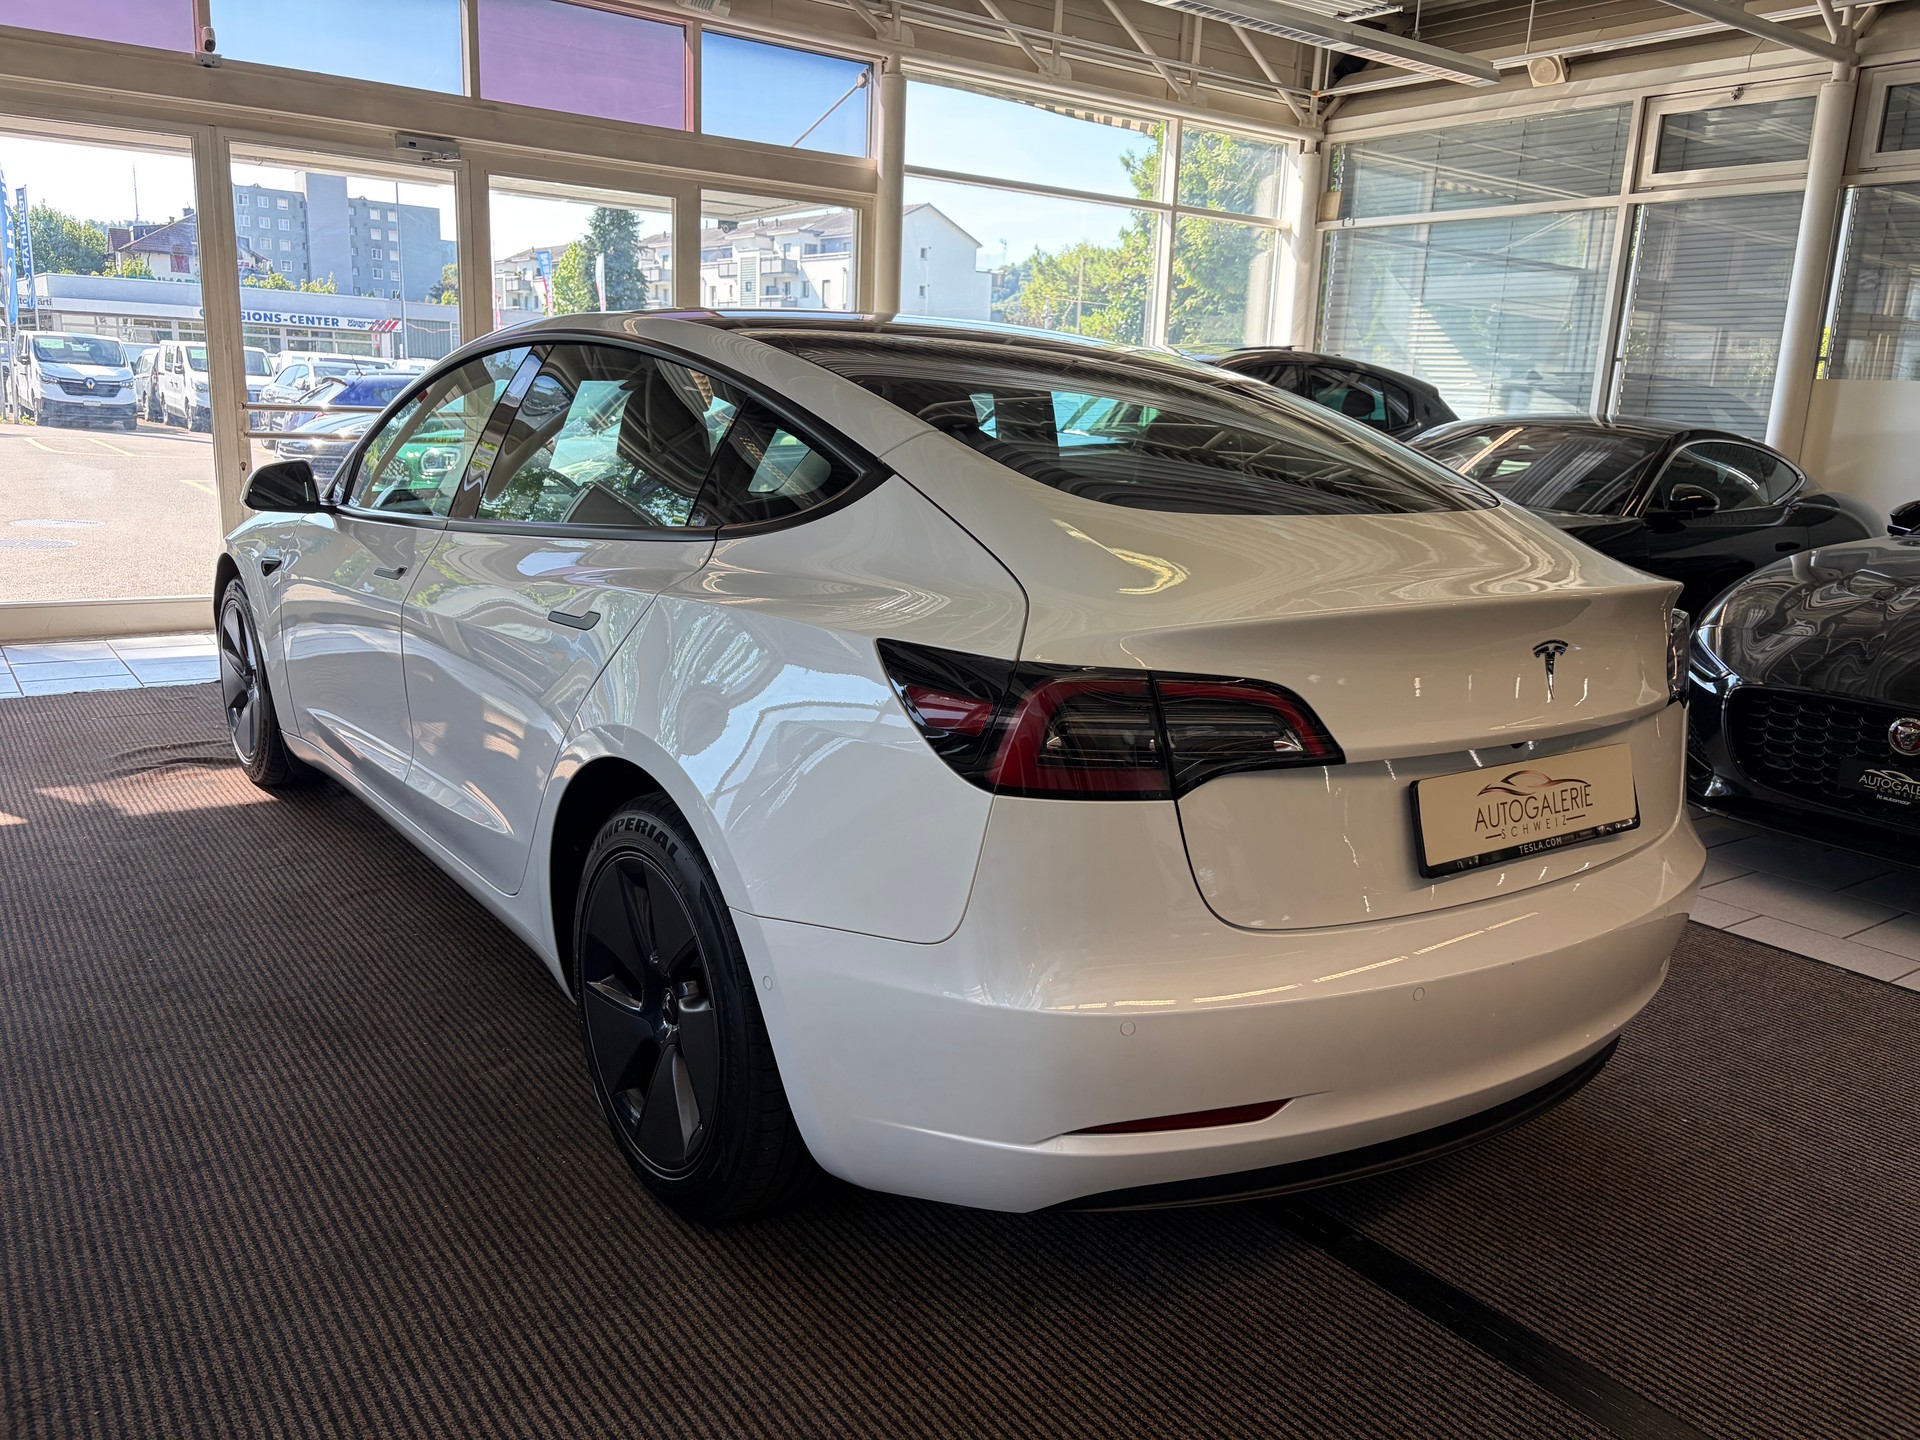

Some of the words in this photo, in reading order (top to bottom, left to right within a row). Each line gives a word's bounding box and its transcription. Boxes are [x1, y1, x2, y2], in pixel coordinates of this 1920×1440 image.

[1474, 784, 1593, 832] AUTOGALERIE
[596, 817, 679, 862] IMPERIAL
[1501, 815, 1567, 840] SCHWEIZ
[1518, 836, 1563, 855] TESLA.COM
